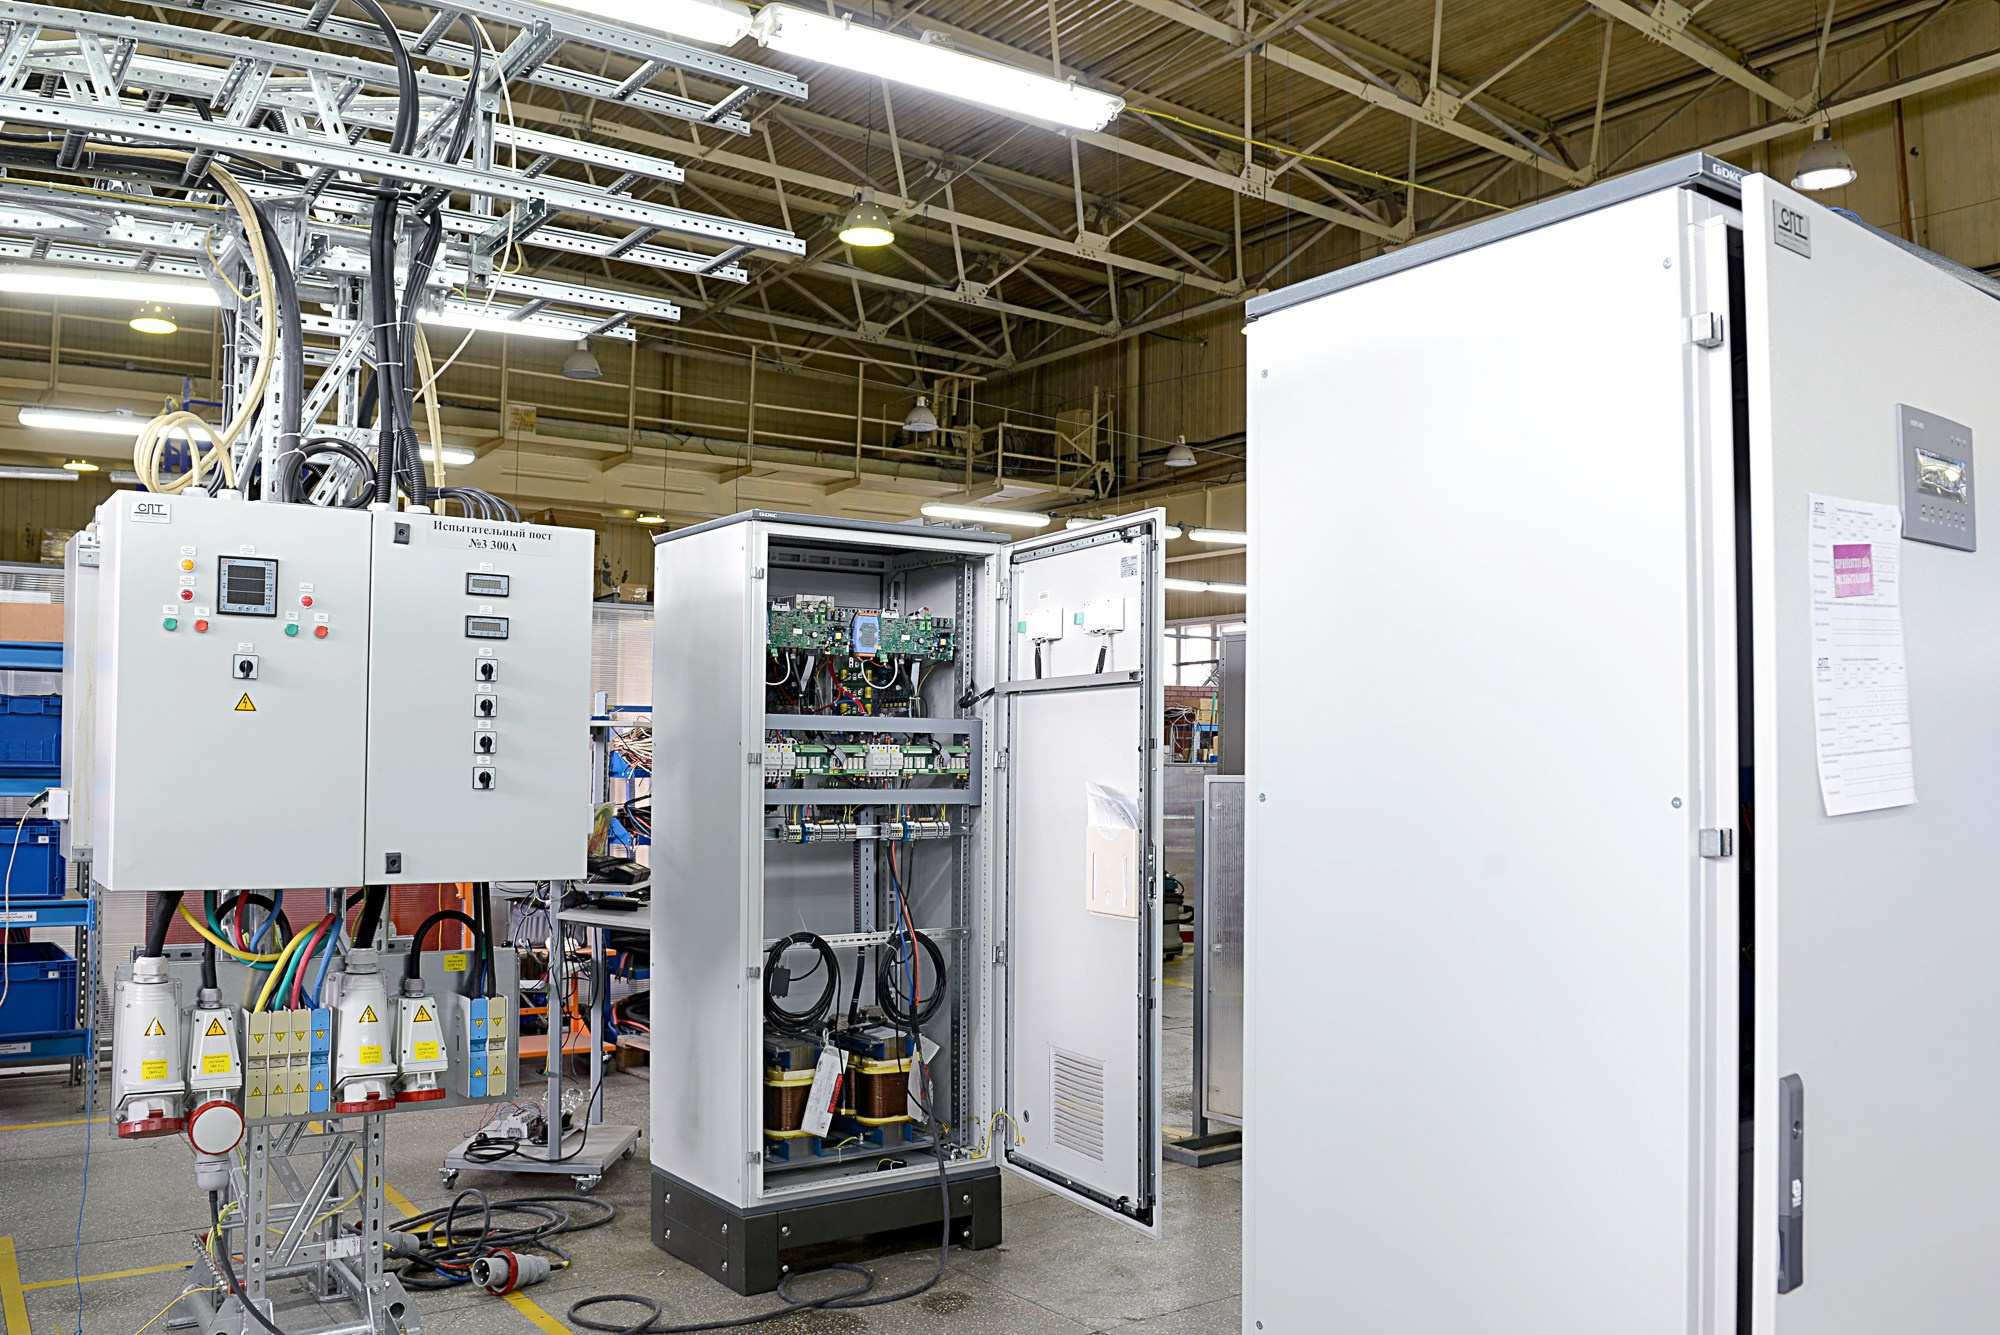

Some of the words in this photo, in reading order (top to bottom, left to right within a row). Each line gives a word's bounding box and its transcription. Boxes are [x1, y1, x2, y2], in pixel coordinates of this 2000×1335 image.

[433, 520, 525, 538] Испытательный
[529, 531, 553, 541] пост
[468, 538, 488, 549] №3
[490, 540, 518, 552] 300А
